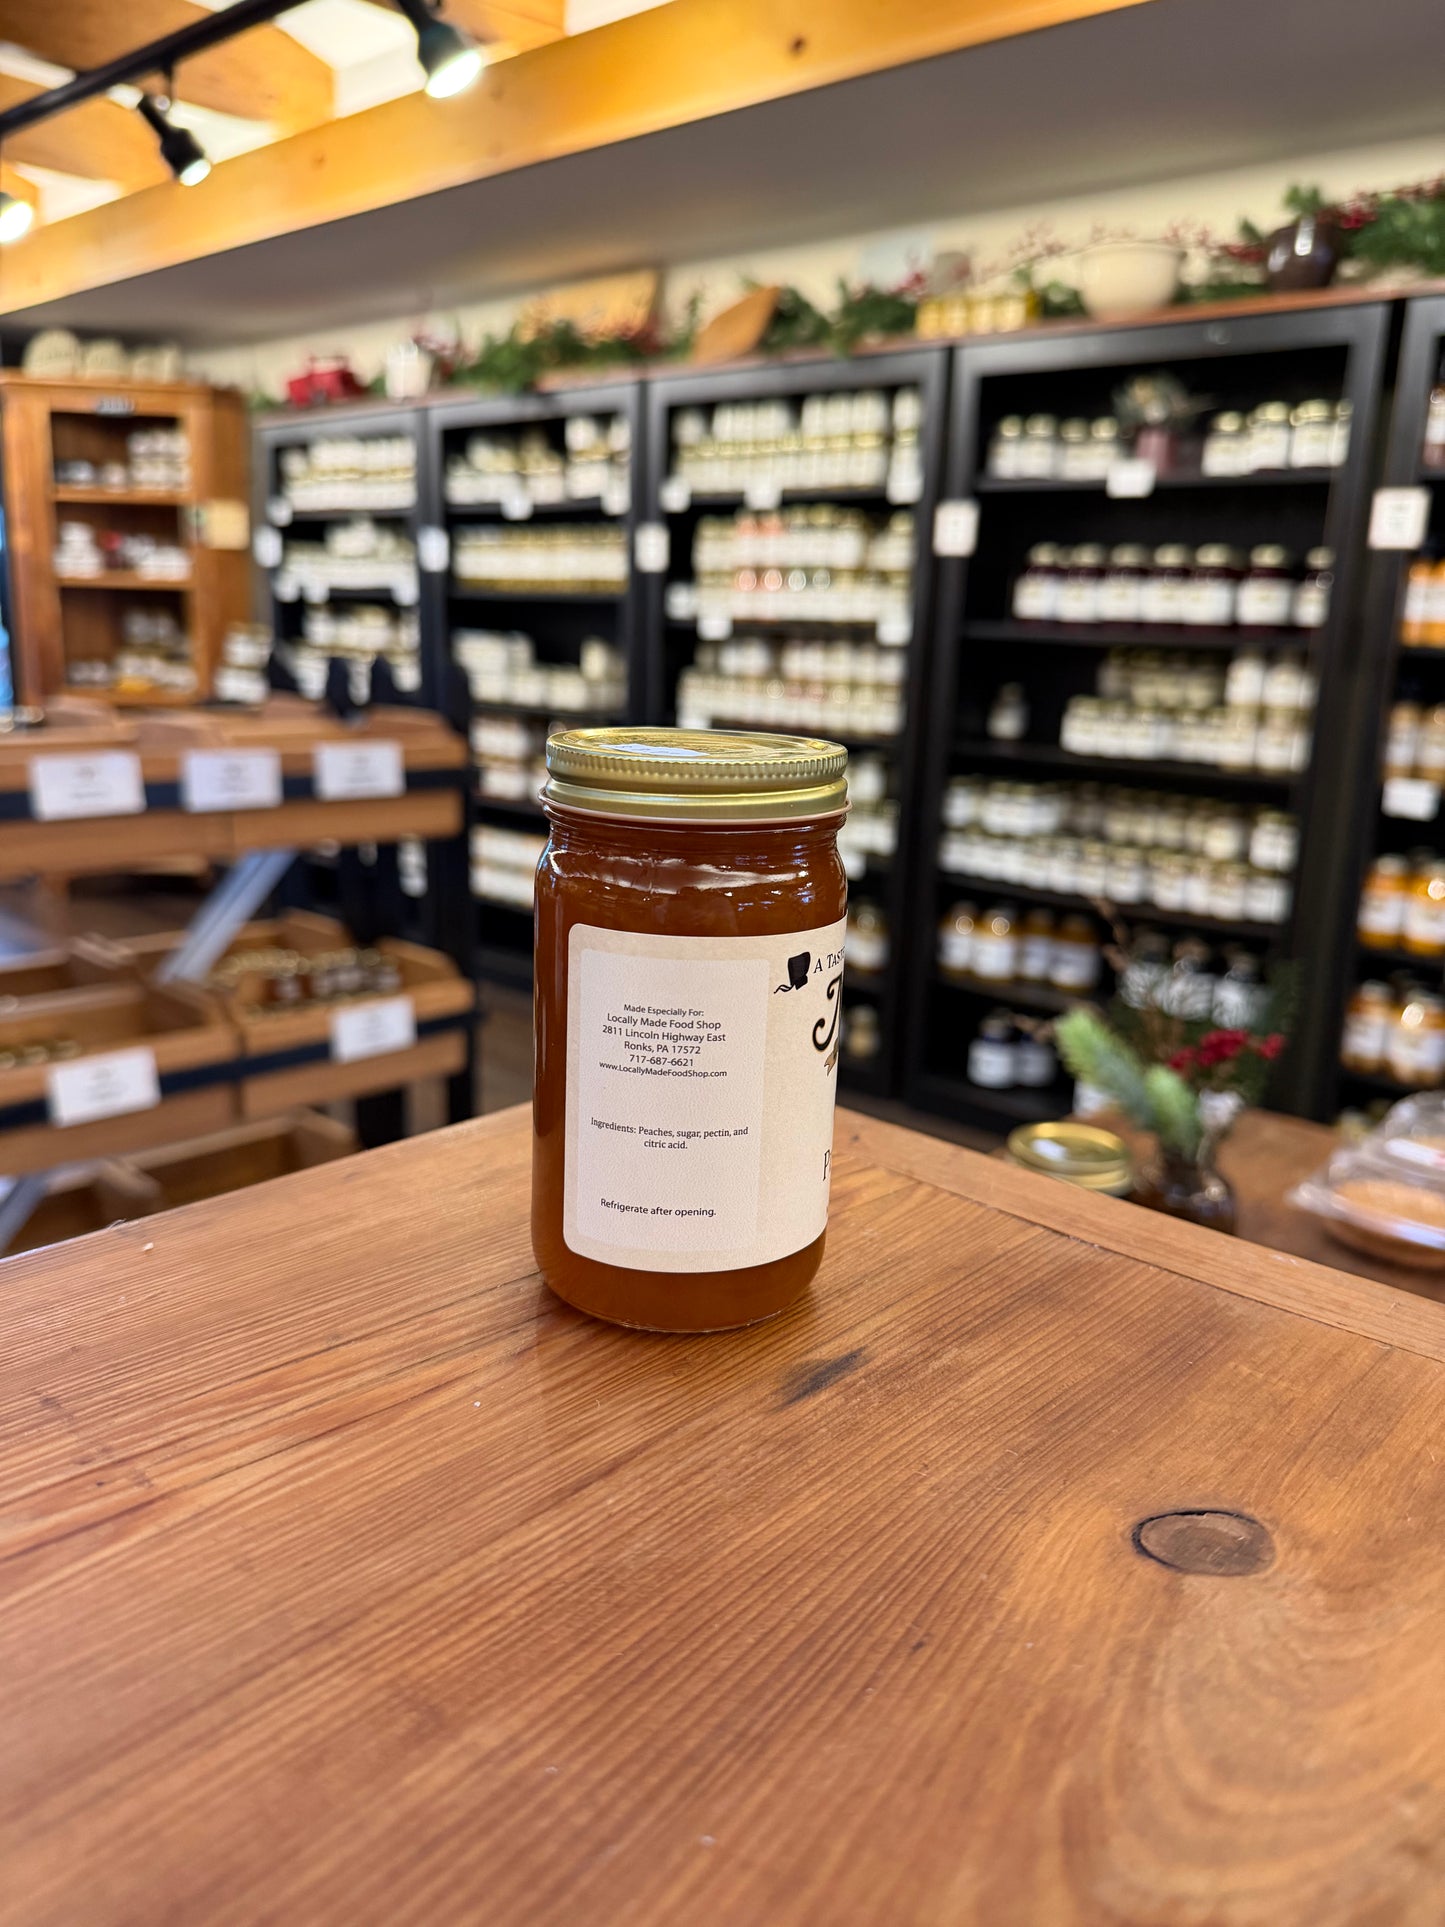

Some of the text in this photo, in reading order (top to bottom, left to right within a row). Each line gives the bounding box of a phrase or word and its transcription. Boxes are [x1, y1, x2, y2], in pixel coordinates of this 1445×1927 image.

[813, 958, 823, 974] A
[623, 1004, 646, 1014] Made
[648, 1006, 686, 1017] Especially
[607, 1013, 721, 1030] Locally Made Food Shop
[602, 1025, 726, 1044] 2811 Lincoln Highway East
[624, 1041, 701, 1054] Ronks, PA 17572
[630, 1054, 694, 1066] 717-687-6621
[599, 1062, 728, 1078] www.LocallyMadeFoodShop.com
[591, 1117, 748, 1139] Ingredients: Peaches, sugar, pectin, and
[644, 1140, 688, 1150] citric acid.
[600, 1198, 716, 1218] Refrigerate after opening.
